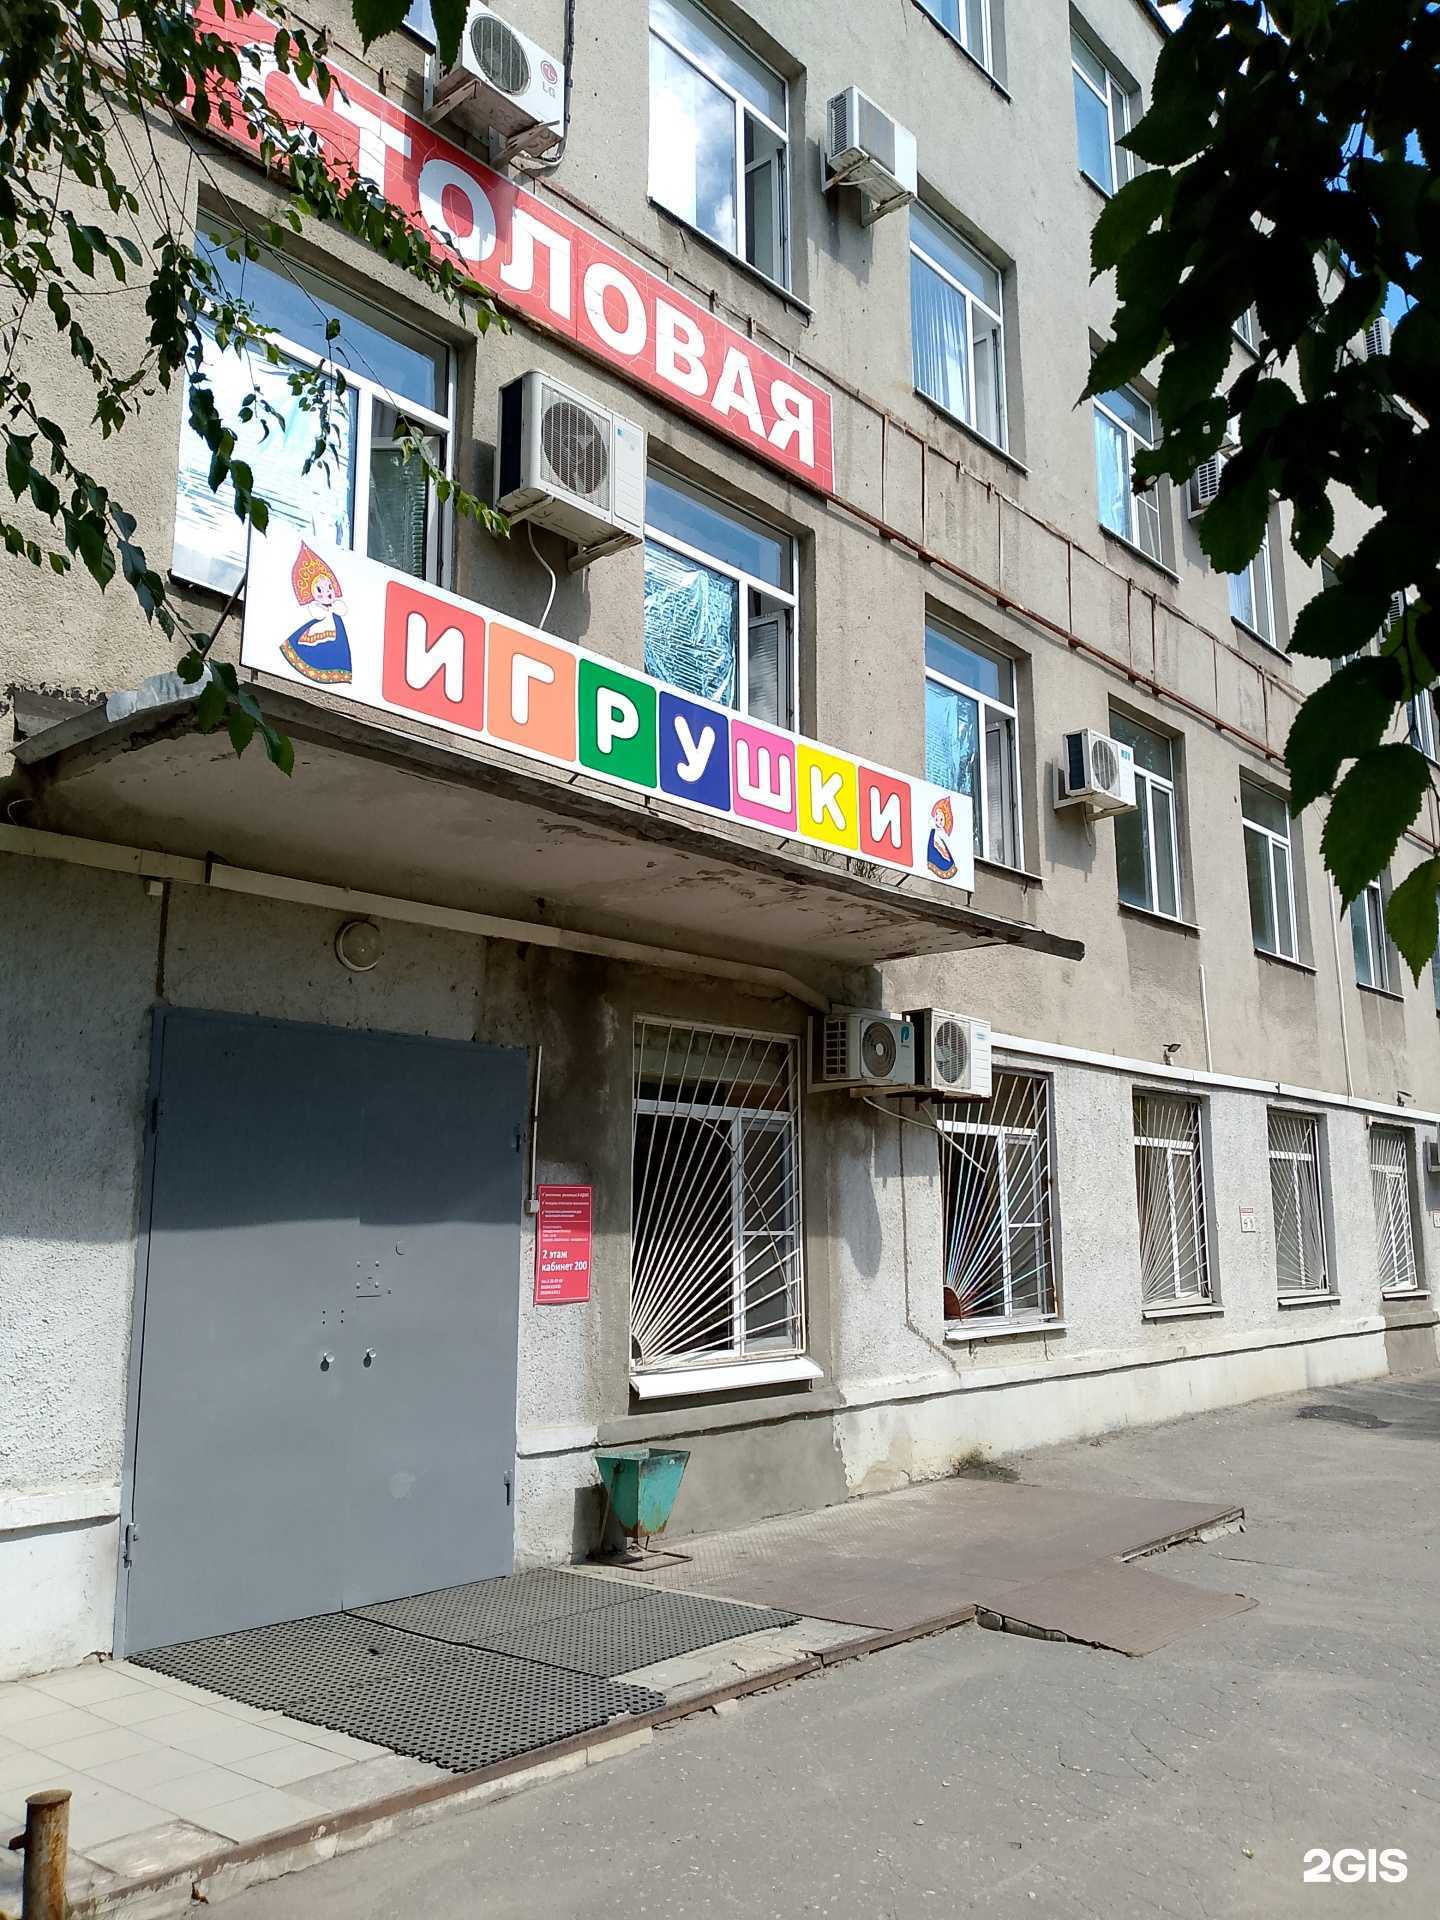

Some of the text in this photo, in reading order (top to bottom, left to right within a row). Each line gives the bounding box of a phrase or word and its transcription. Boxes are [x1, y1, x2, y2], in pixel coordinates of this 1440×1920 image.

[235, 42, 815, 468] СТОЛОВАЯ
[404, 611, 902, 849] ИГРУШКИ
[541, 1261, 588, 1272] кабинет 200
[542, 1250, 568, 1259] 2 этаж
